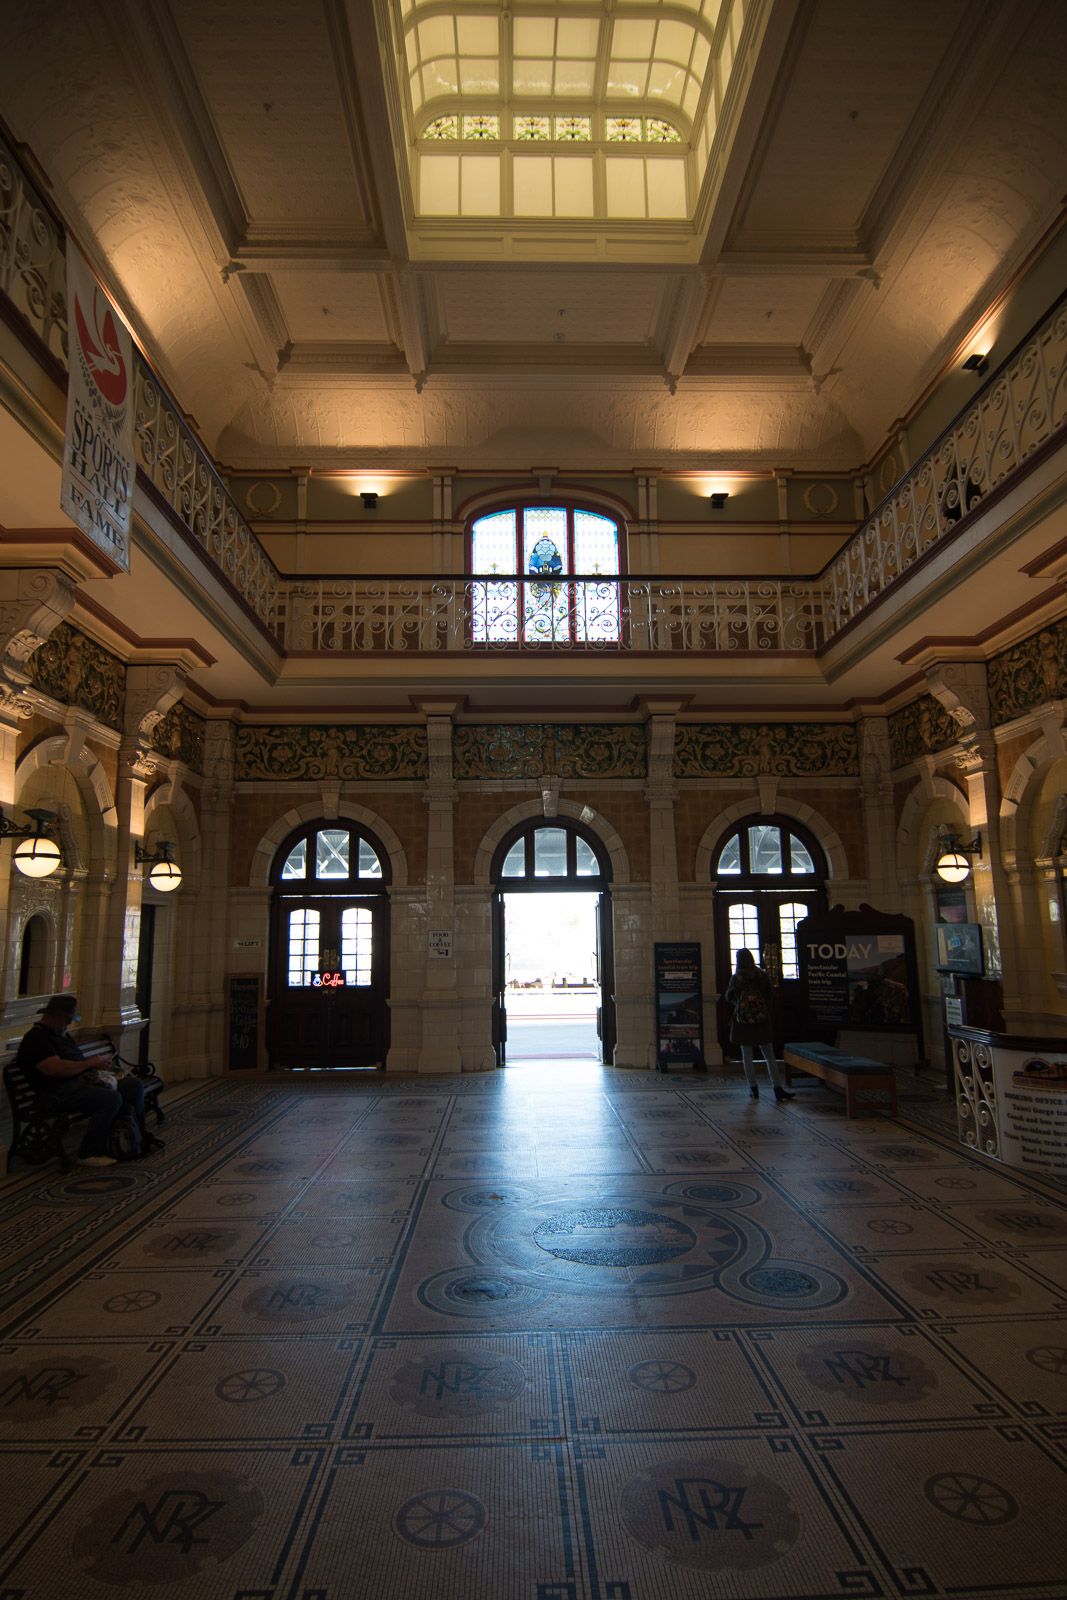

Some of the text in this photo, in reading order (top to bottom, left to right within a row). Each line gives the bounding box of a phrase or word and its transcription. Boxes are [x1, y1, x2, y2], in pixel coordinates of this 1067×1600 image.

[72, 410, 129, 503] SPORTS
[69, 446, 126, 521] HALL
[70, 483, 124, 551] FAME
[806, 943, 873, 960] TODAY
[322, 972, 344, 987] Coffee
[1004, 1092, 1033, 1103] BOOKING
[1035, 1097, 1063, 1106] OFFICE
